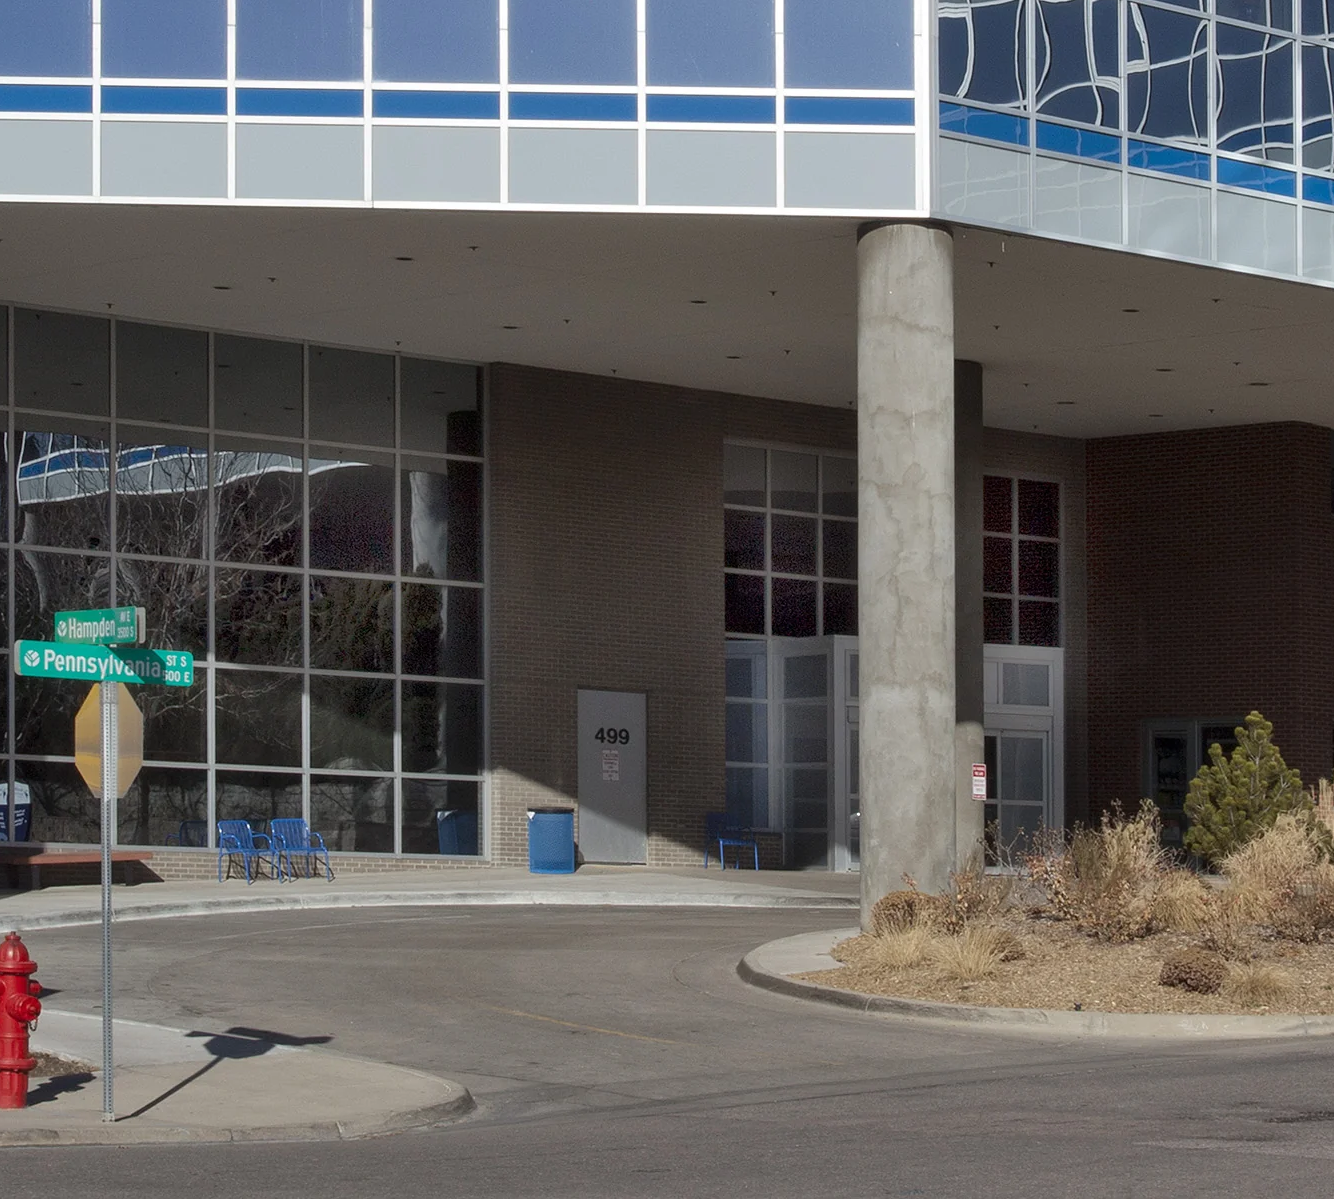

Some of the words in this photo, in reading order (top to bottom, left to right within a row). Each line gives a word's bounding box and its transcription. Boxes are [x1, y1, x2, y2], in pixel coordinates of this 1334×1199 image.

[68, 617, 116, 642] Hampden
[130, 626, 134, 638] S
[44, 649, 161, 679] Pennsylvania
[166, 655, 177, 667] ST
[180, 656, 187, 667] S
[163, 670, 181, 682] 500
[184, 671, 190, 683] E
[594, 727, 630, 745] 499
